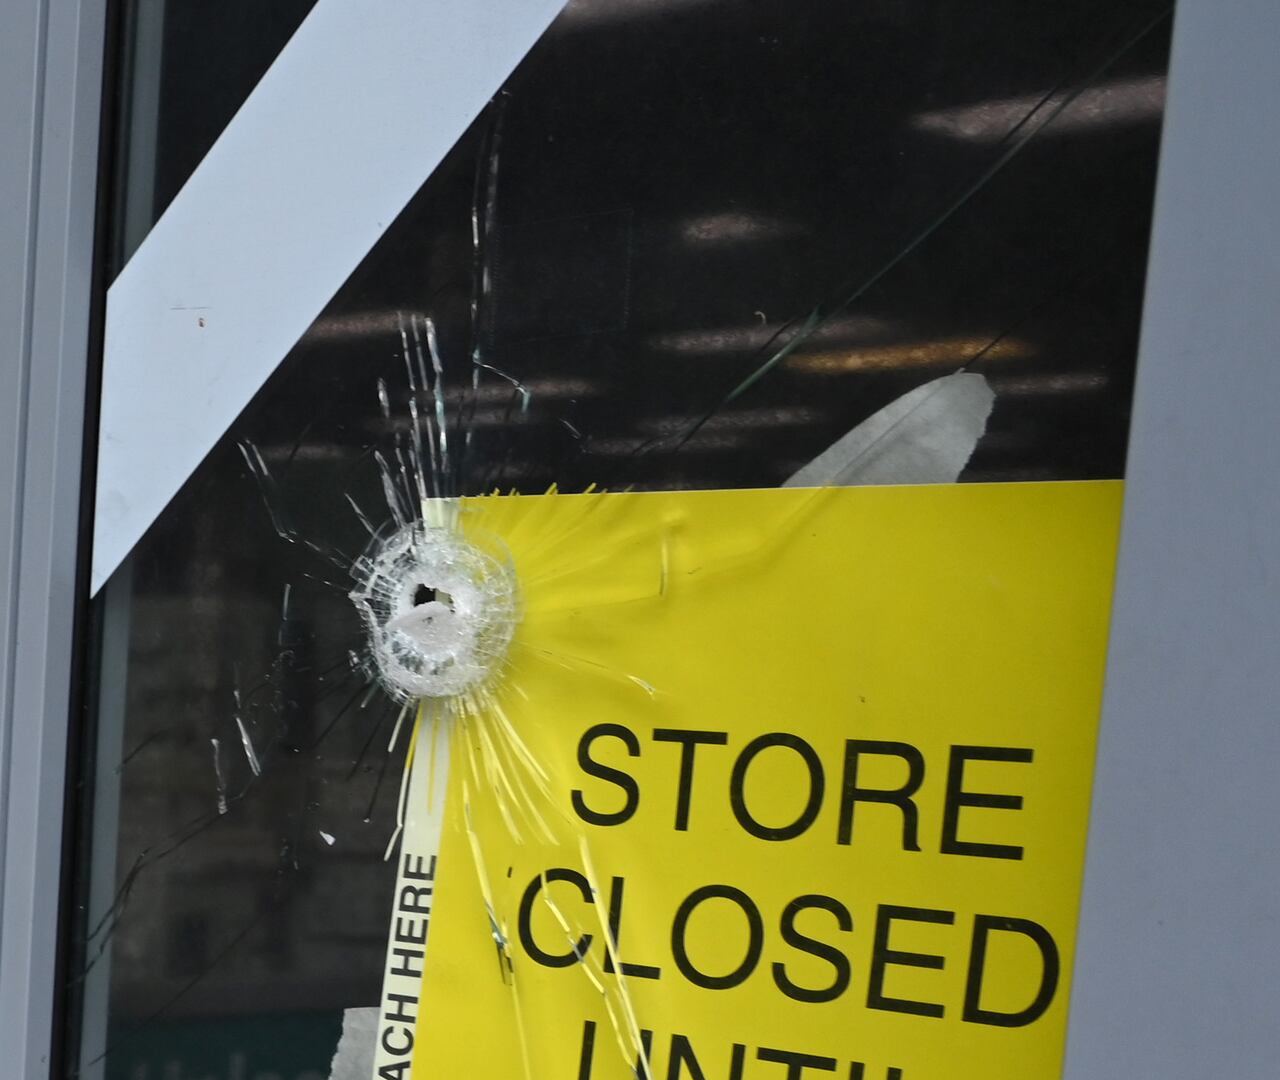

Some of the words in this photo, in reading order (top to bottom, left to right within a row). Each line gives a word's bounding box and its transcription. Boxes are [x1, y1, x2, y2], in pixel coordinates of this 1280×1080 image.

[570, 722, 1034, 861] STORE
[389, 853, 437, 978] HERE
[517, 867, 1060, 1028] CLOSED
